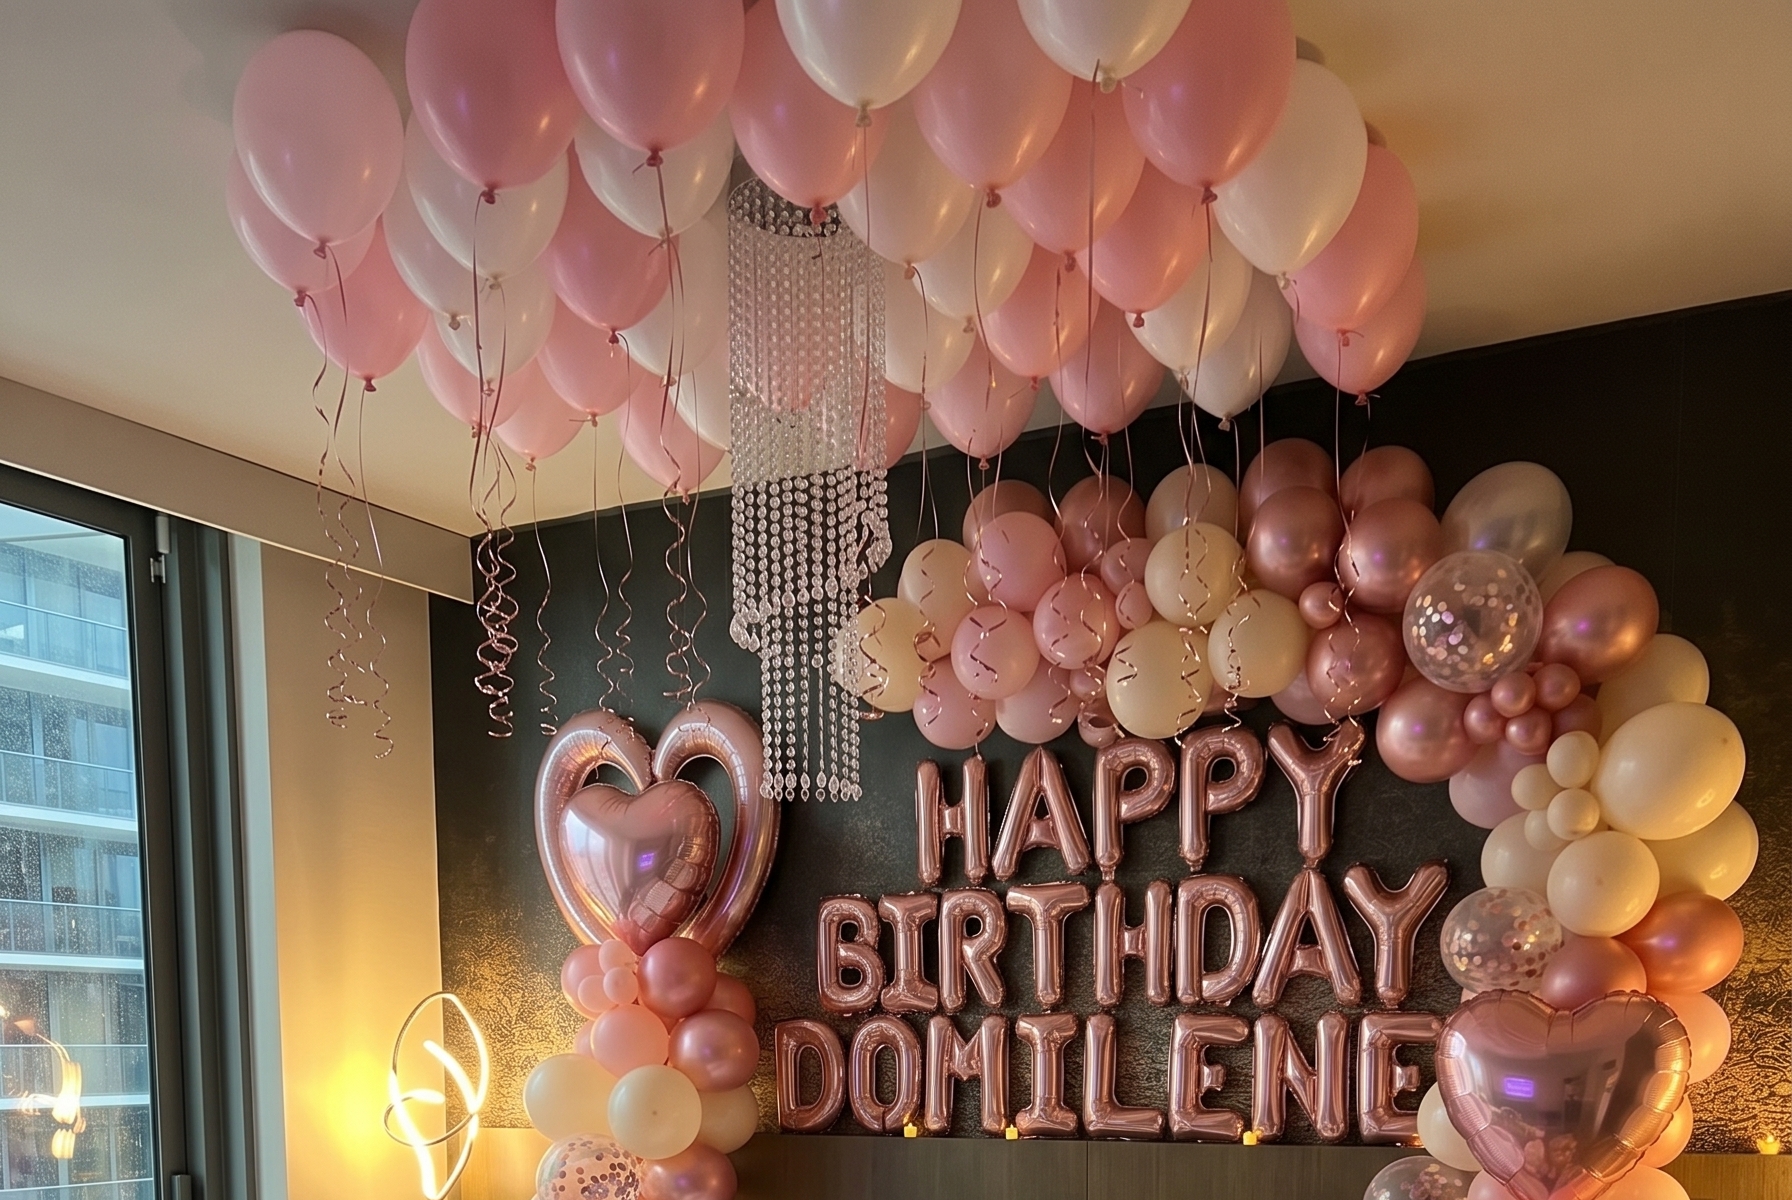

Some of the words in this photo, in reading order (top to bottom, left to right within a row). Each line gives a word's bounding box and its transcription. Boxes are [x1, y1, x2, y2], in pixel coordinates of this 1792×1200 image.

[916, 720, 1366, 886] HAPPY
[817, 861, 1450, 1014] BIRTHDAY
[776, 1011, 1444, 1143] DOMILENE
